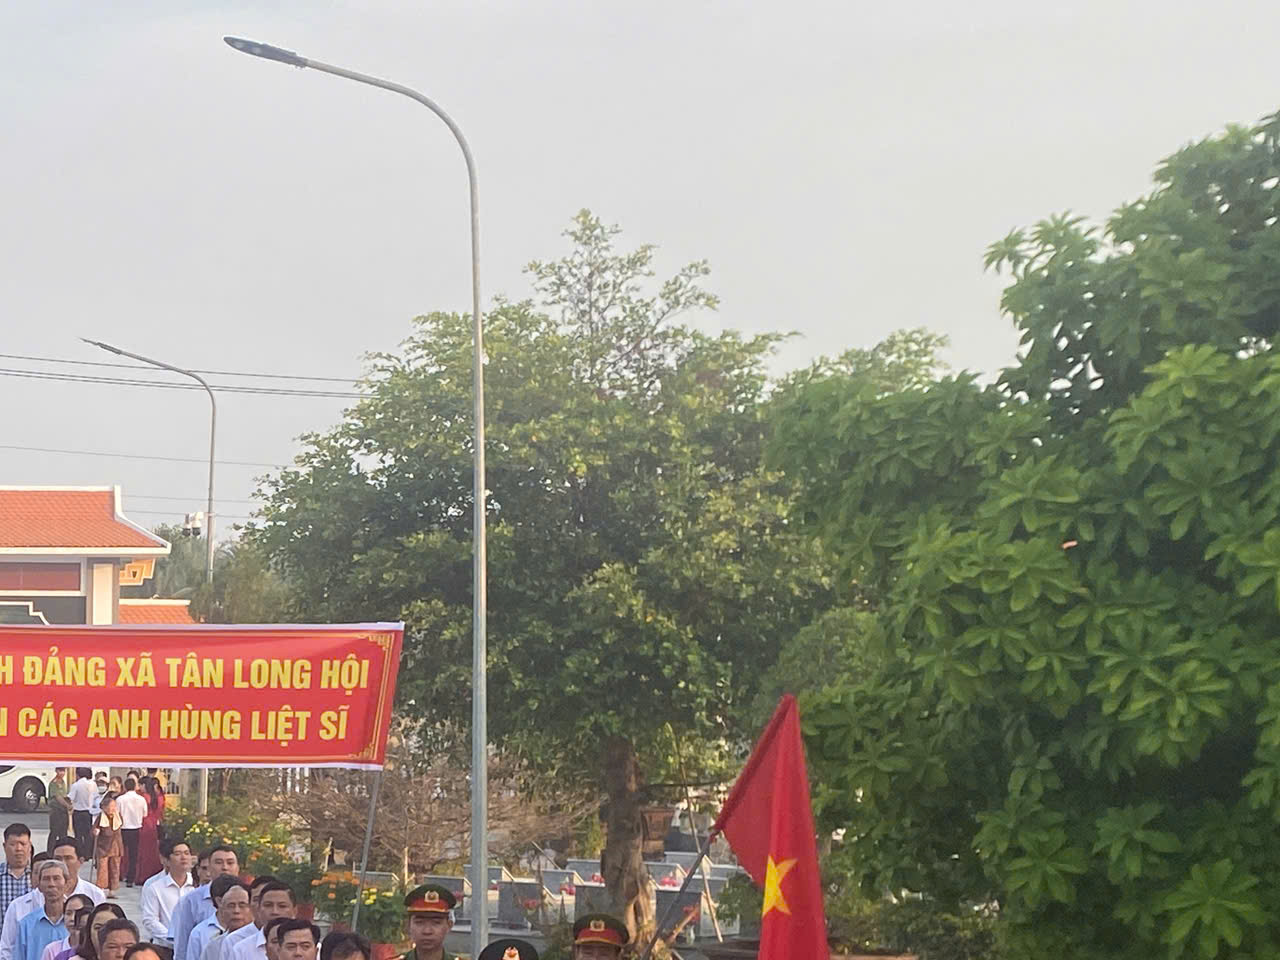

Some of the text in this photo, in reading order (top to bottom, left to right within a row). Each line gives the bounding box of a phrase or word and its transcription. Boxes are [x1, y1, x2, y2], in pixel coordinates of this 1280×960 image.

[22, 646, 107, 688] ĐẢNG
[115, 651, 157, 688] XÃ
[164, 651, 225, 689] TÂN
[233, 658, 312, 690] LONG
[320, 653, 370, 696] HỘI
[17, 701, 78, 739] CÁC
[86, 708, 150, 740] ANH
[159, 703, 242, 741] HÙNG
[250, 704, 312, 747] LIỆT
[318, 704, 350, 741] SĨ
